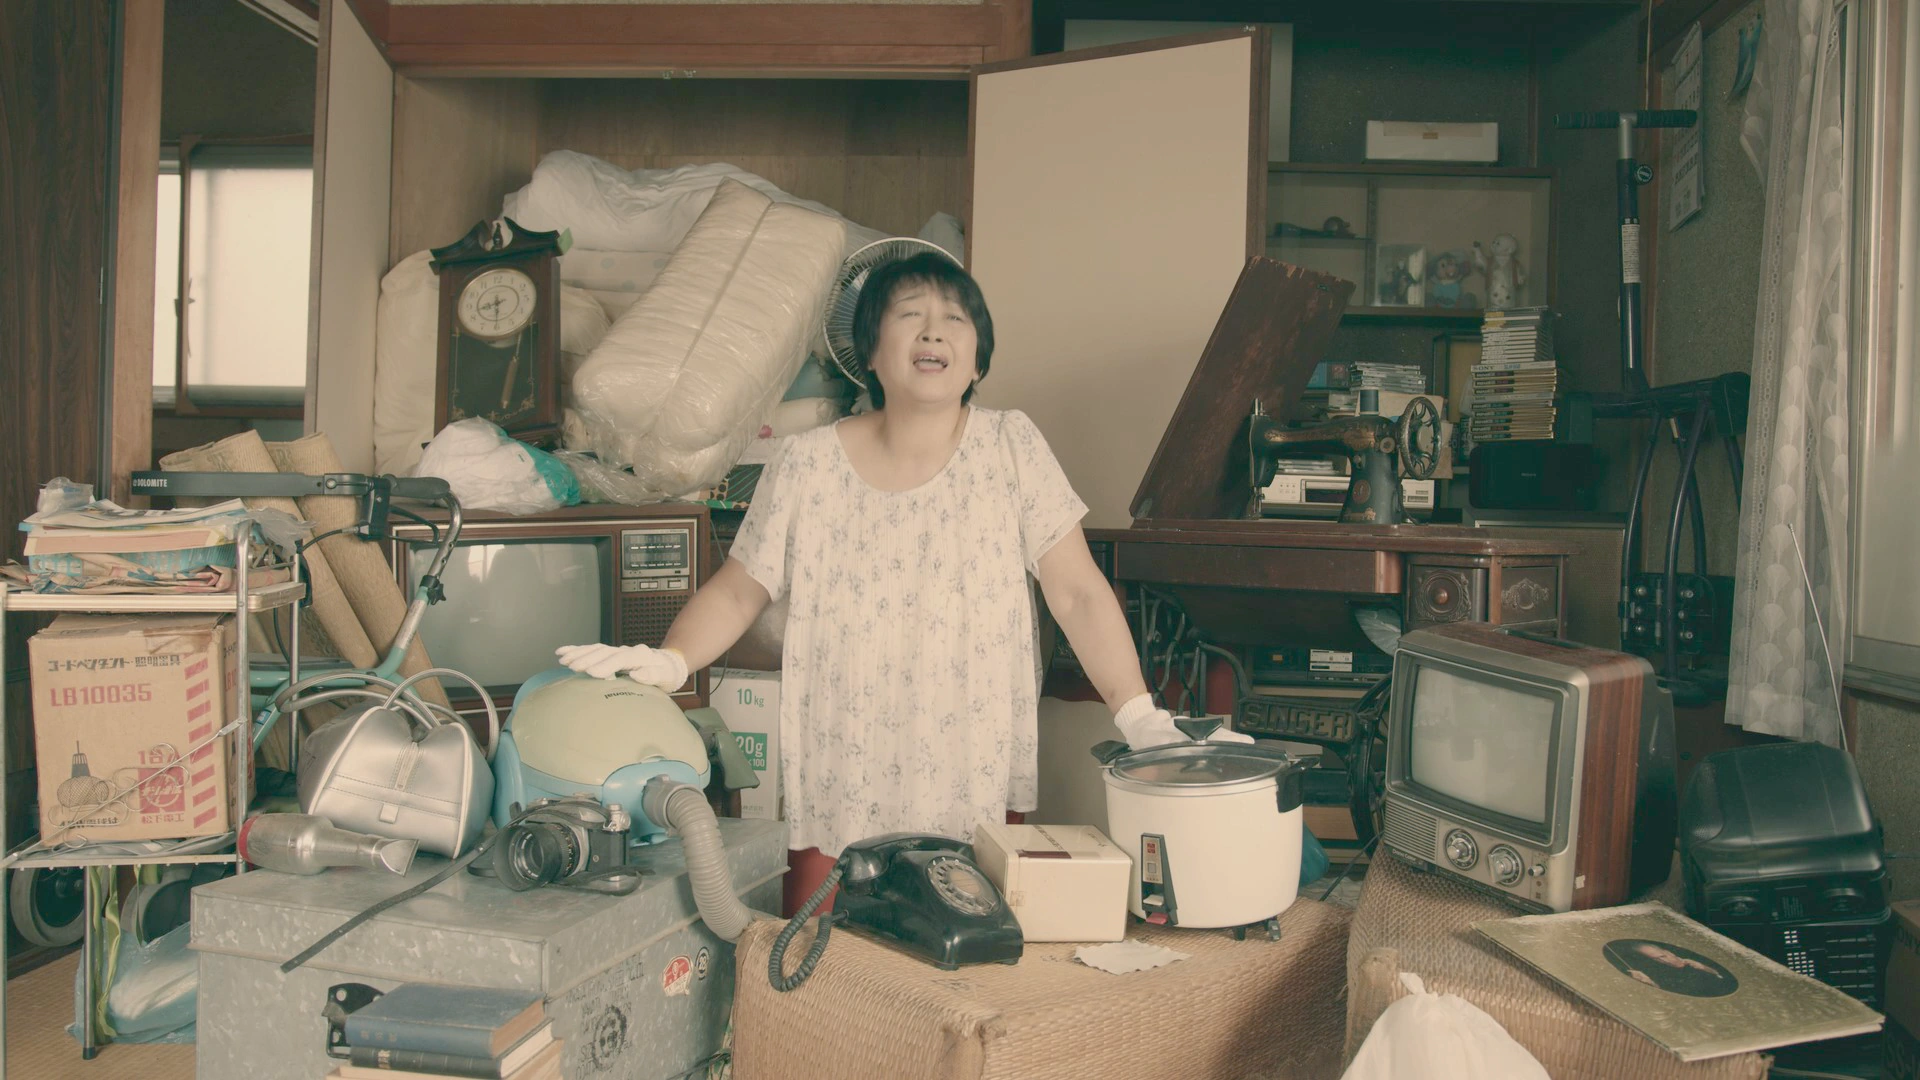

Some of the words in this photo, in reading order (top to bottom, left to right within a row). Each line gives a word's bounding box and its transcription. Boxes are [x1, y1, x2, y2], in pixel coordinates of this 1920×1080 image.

[137, 478, 168, 488] DOLOMITE
[50, 683, 152, 707] LB10035
[736, 687, 752, 705] 10
[754, 695, 764, 708] kg
[1241, 703, 1352, 741] SINGER
